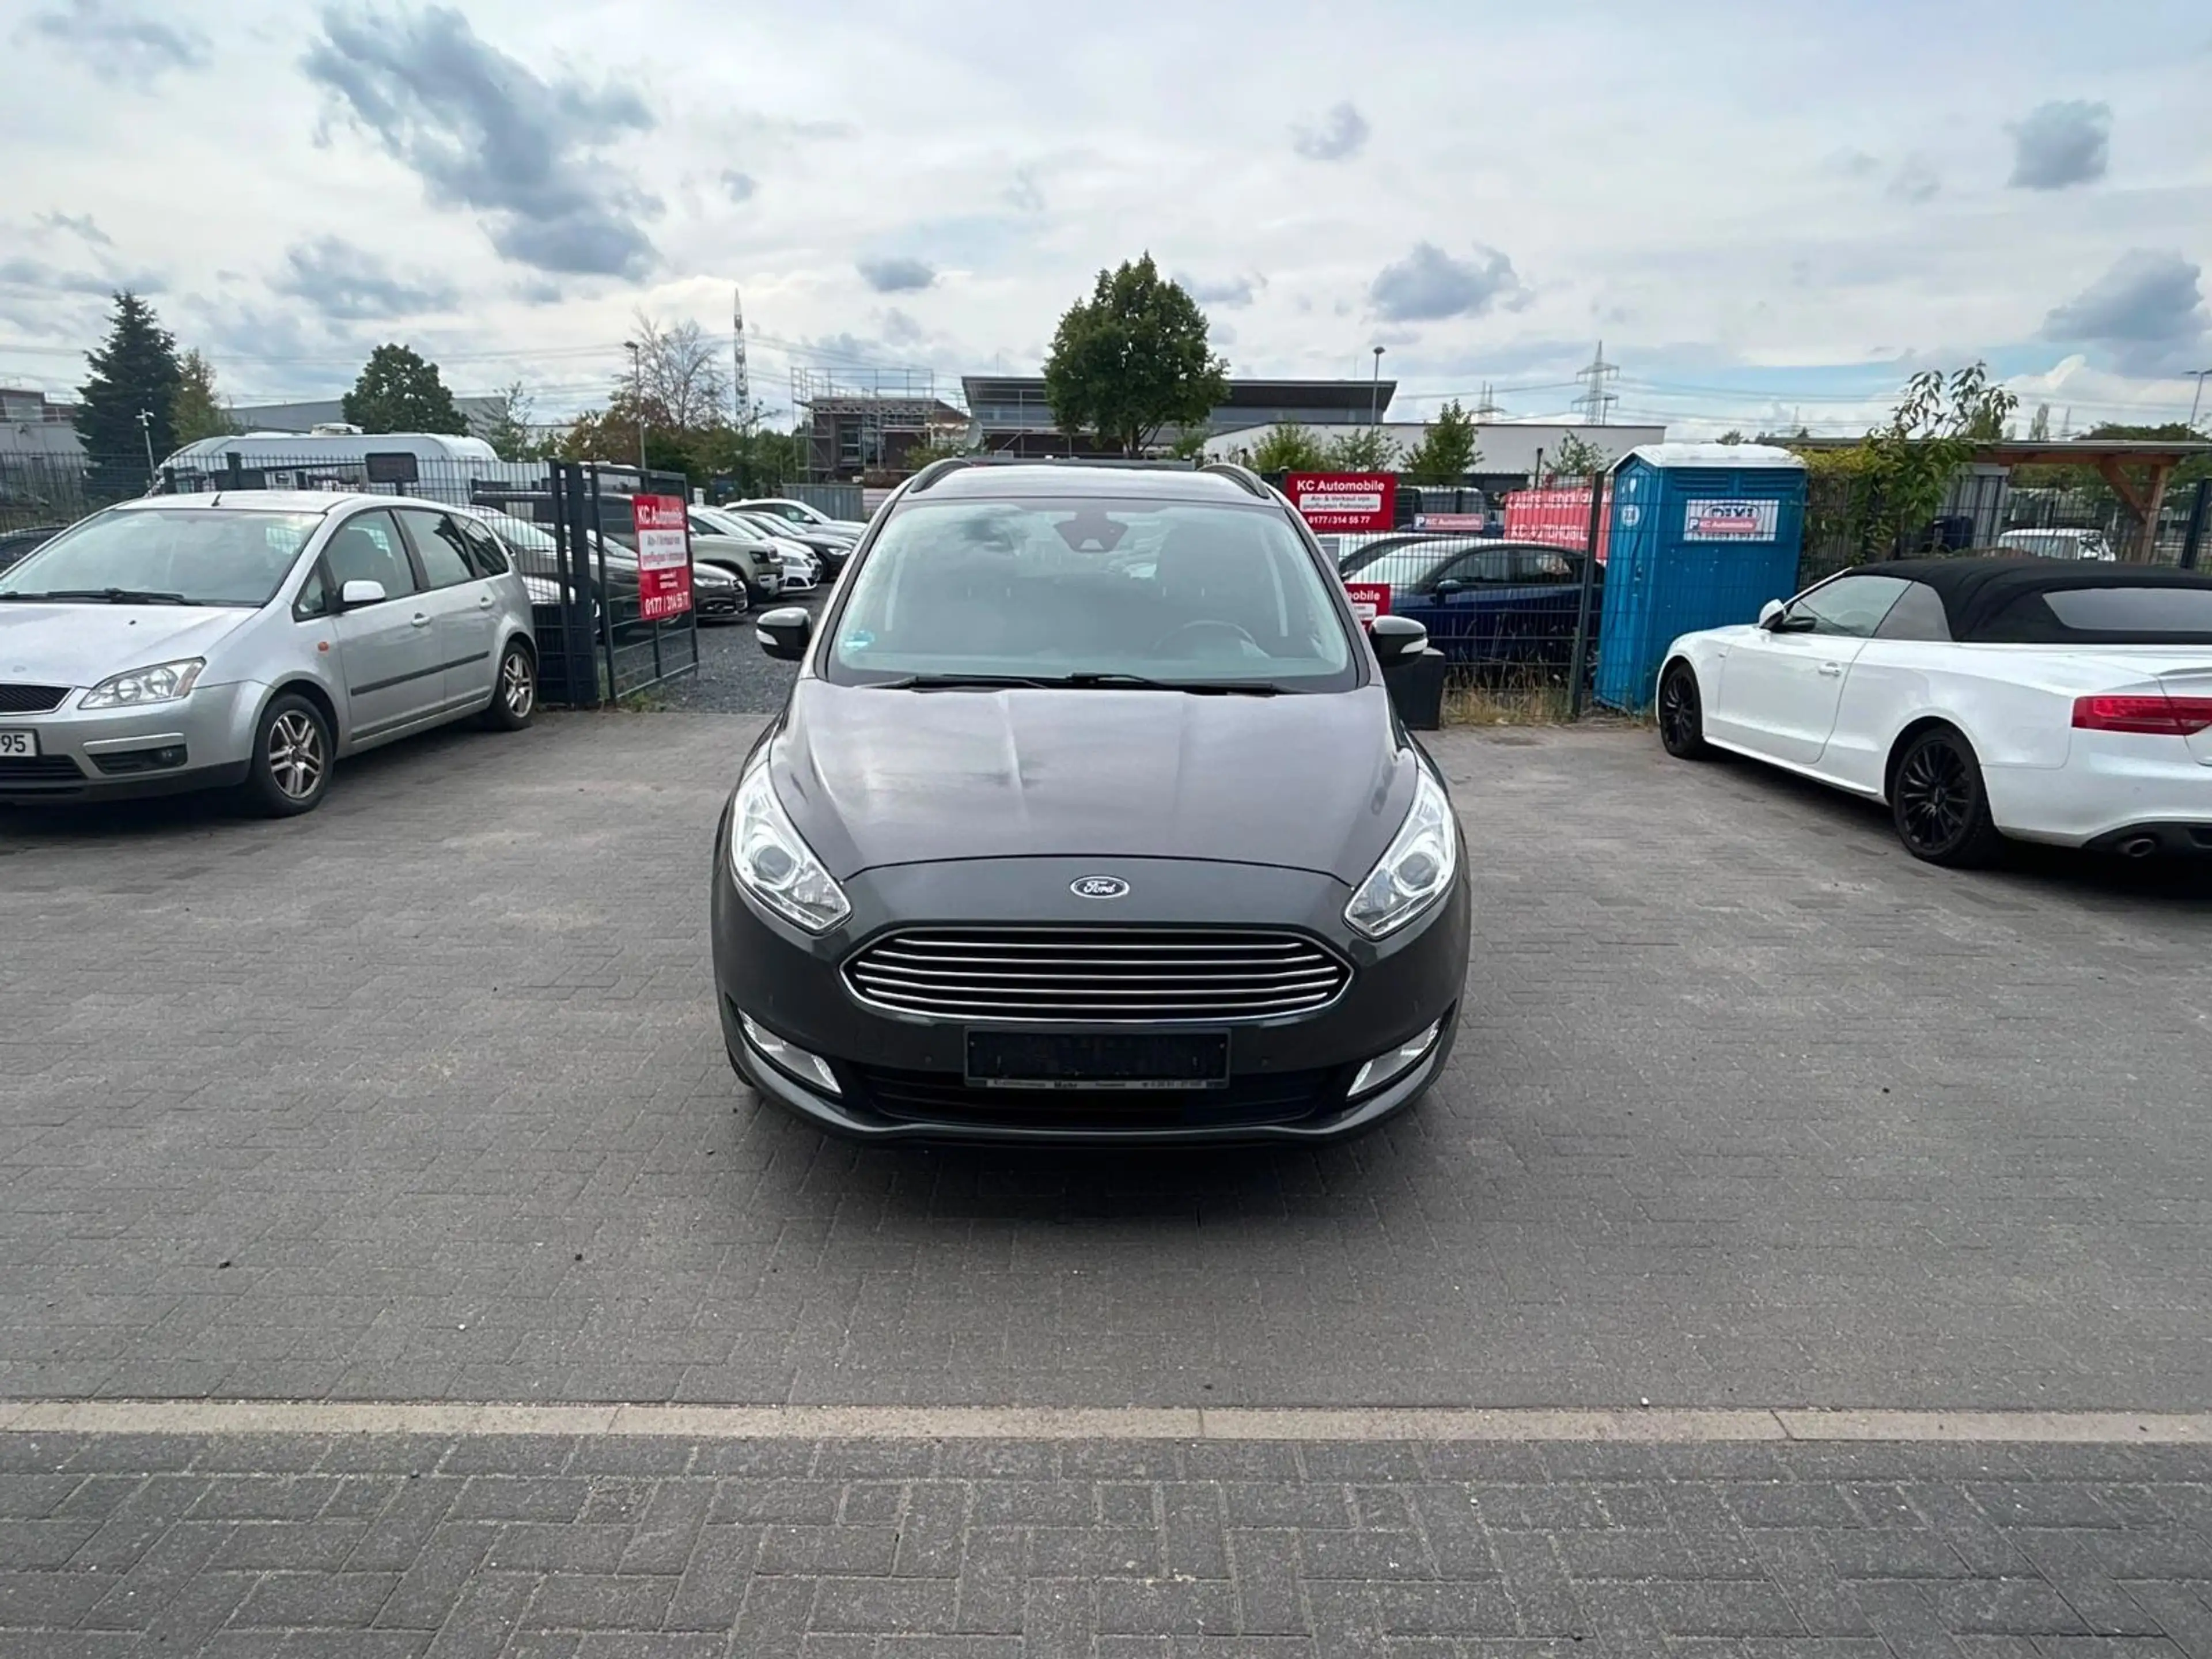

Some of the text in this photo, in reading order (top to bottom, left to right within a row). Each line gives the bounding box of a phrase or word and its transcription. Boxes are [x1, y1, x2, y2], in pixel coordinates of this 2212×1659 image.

[1297, 480, 1385, 492] KC Automobile
[1, 734, 26, 753] 95
[1084, 880, 1116, 893] Ford
